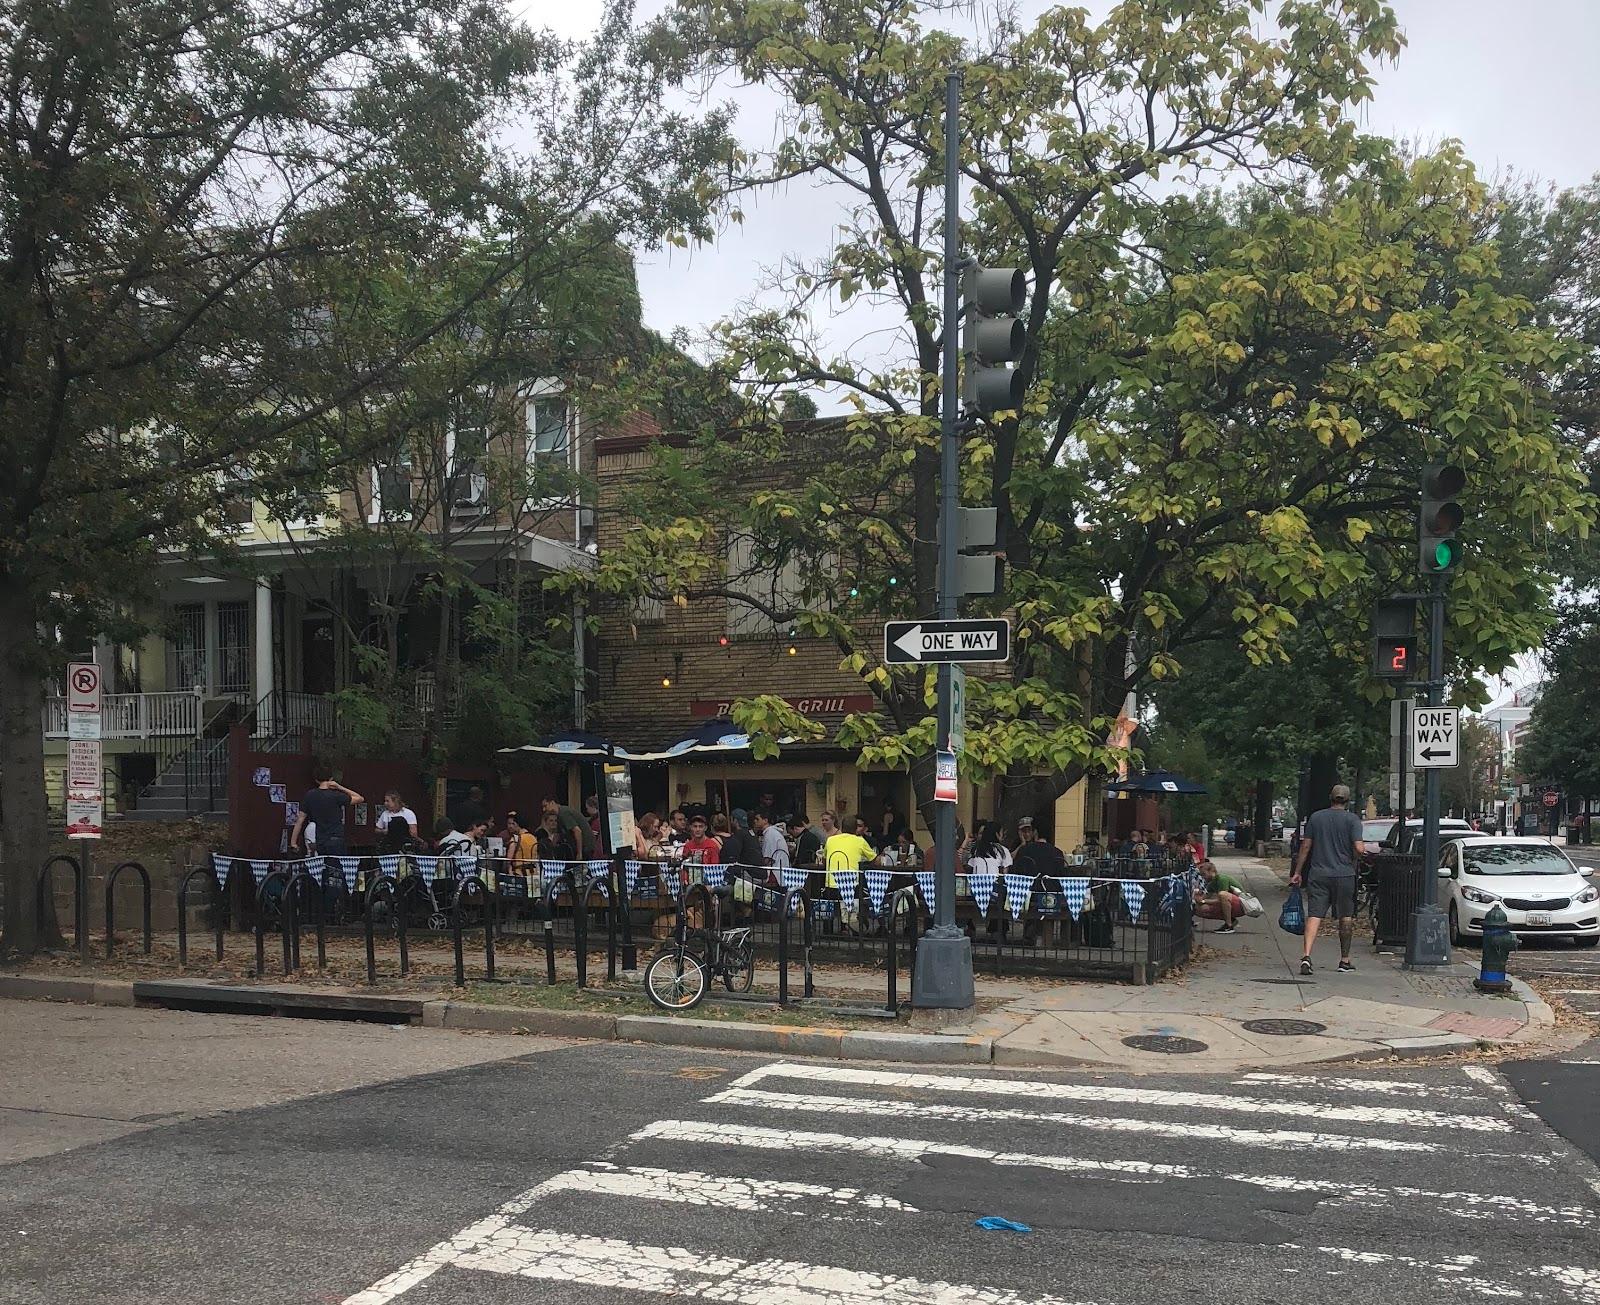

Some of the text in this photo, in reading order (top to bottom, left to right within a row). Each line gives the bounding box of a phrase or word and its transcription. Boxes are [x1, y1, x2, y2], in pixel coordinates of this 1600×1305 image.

[922, 632, 994, 650] ONE WAY
[1392, 646, 1406, 668] 2
[798, 699, 845, 713] GRILL
[1418, 712, 1453, 727] ONE
[1417, 729, 1454, 743] WAY
